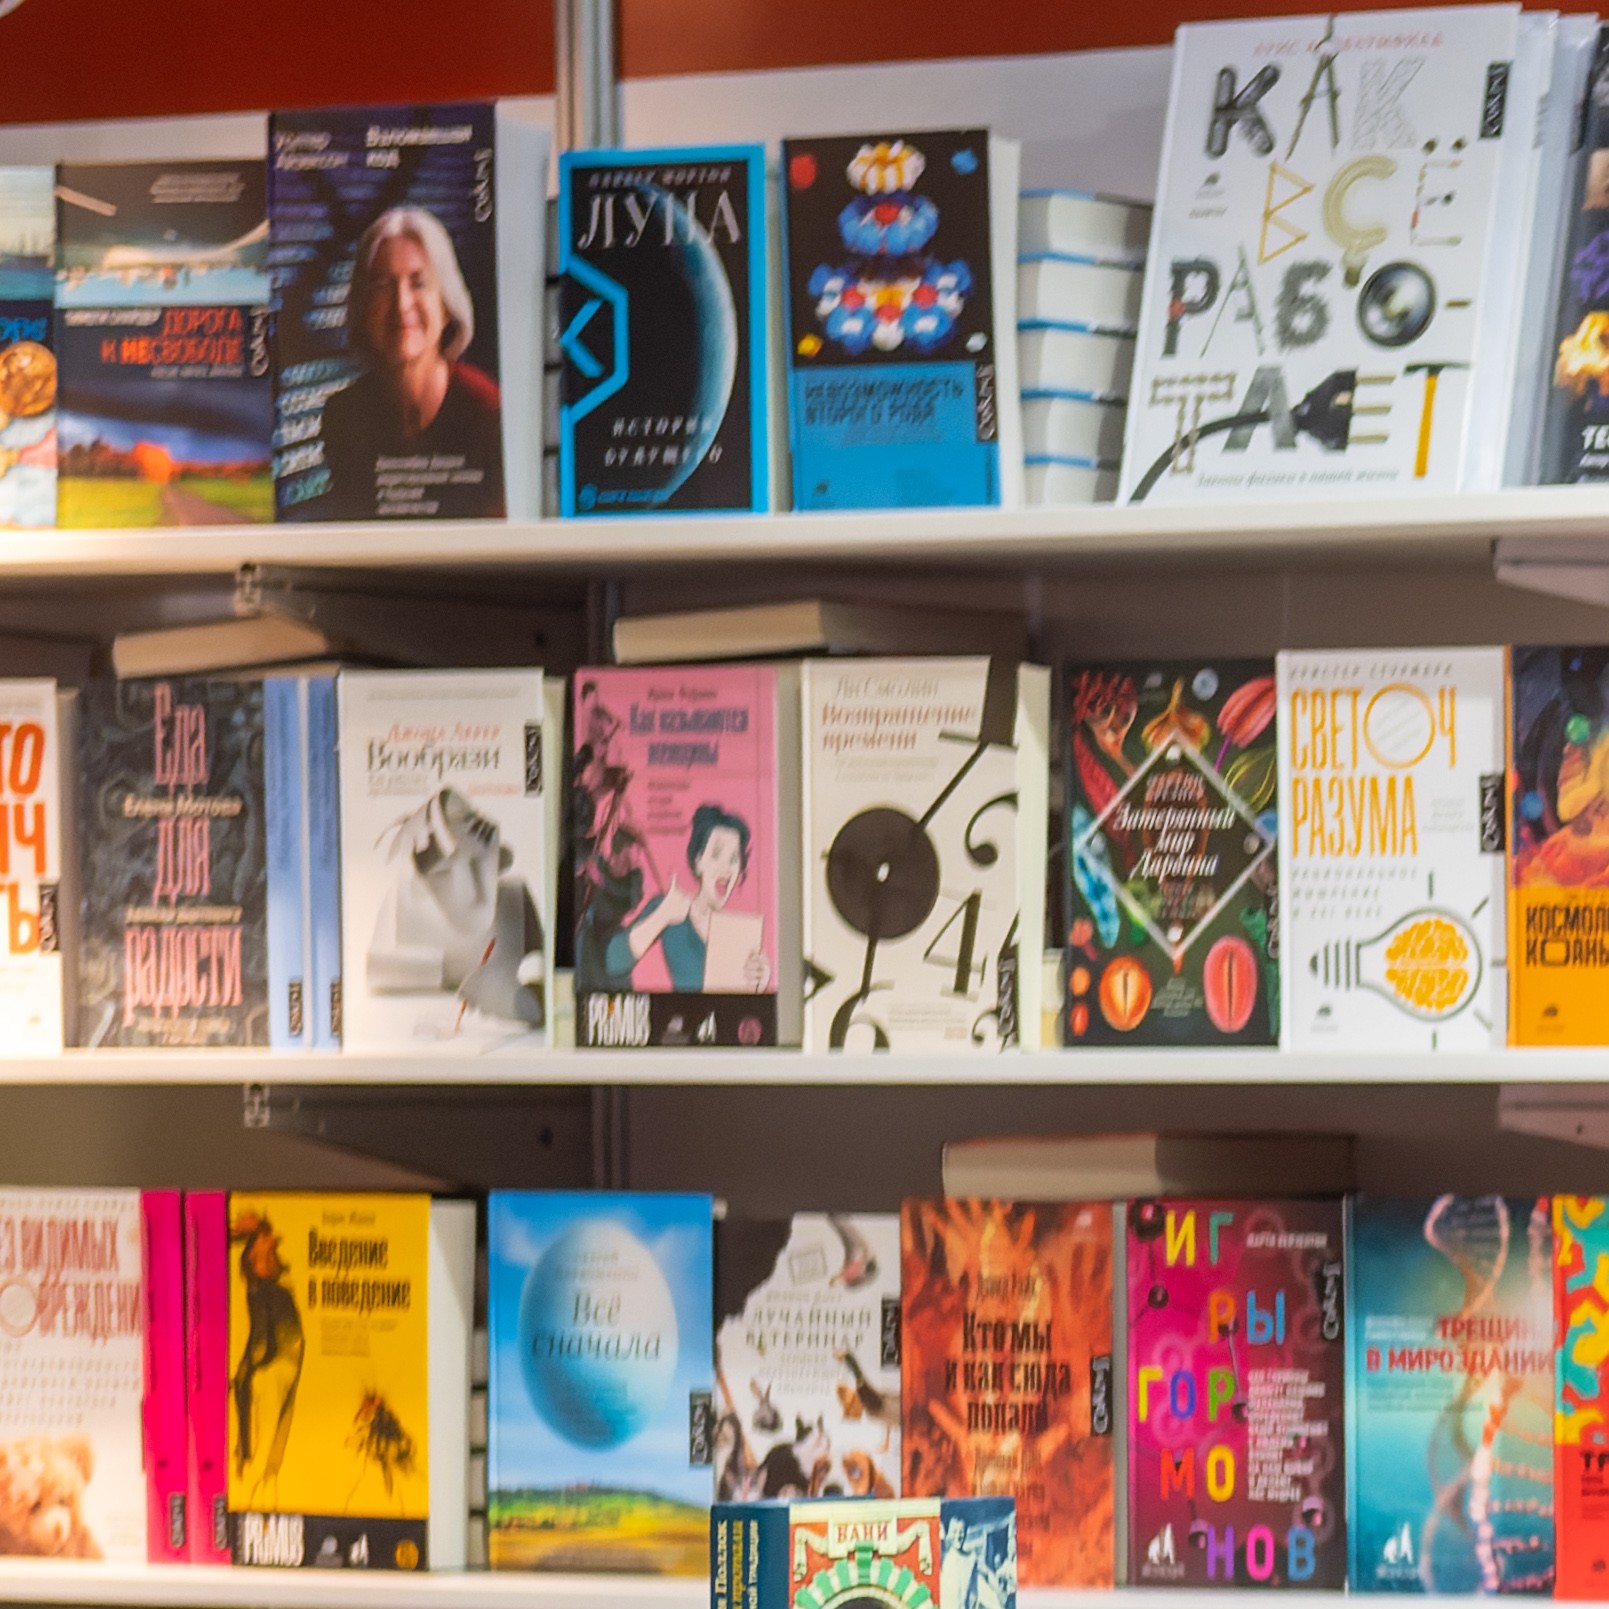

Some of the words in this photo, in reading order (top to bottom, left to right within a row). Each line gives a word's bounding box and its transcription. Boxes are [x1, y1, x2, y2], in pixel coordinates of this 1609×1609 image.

[1204, 52, 1426, 161] КАК
[578, 189, 742, 249] ЛУНА
[1258, 138, 1468, 289] ВСЁ
[153, 681, 210, 797] Еда
[1290, 682, 1457, 771] СВЕТОЧ
[366, 742, 501, 785] Вообрази
[1290, 774, 1418, 858] РАЗУМА
[122, 926, 243, 1028] радости
[308, 1229, 389, 1280] Введение
[1165, 1209, 1235, 1267] ИГ
[320, 1276, 412, 1316] поведение
[1208, 1290, 1286, 1345] РЫ
[531, 1330, 662, 1362] сначала
[962, 1314, 1006, 1352] Кто
[1010, 1319, 1053, 1352] мы
[1386, 1345, 1555, 1378] МИРОЗДАНИИ
[1137, 1366, 1236, 1423] ГОР
[1159, 1445, 1236, 1503] МО
[1205, 1525, 1316, 1582] НОВ
